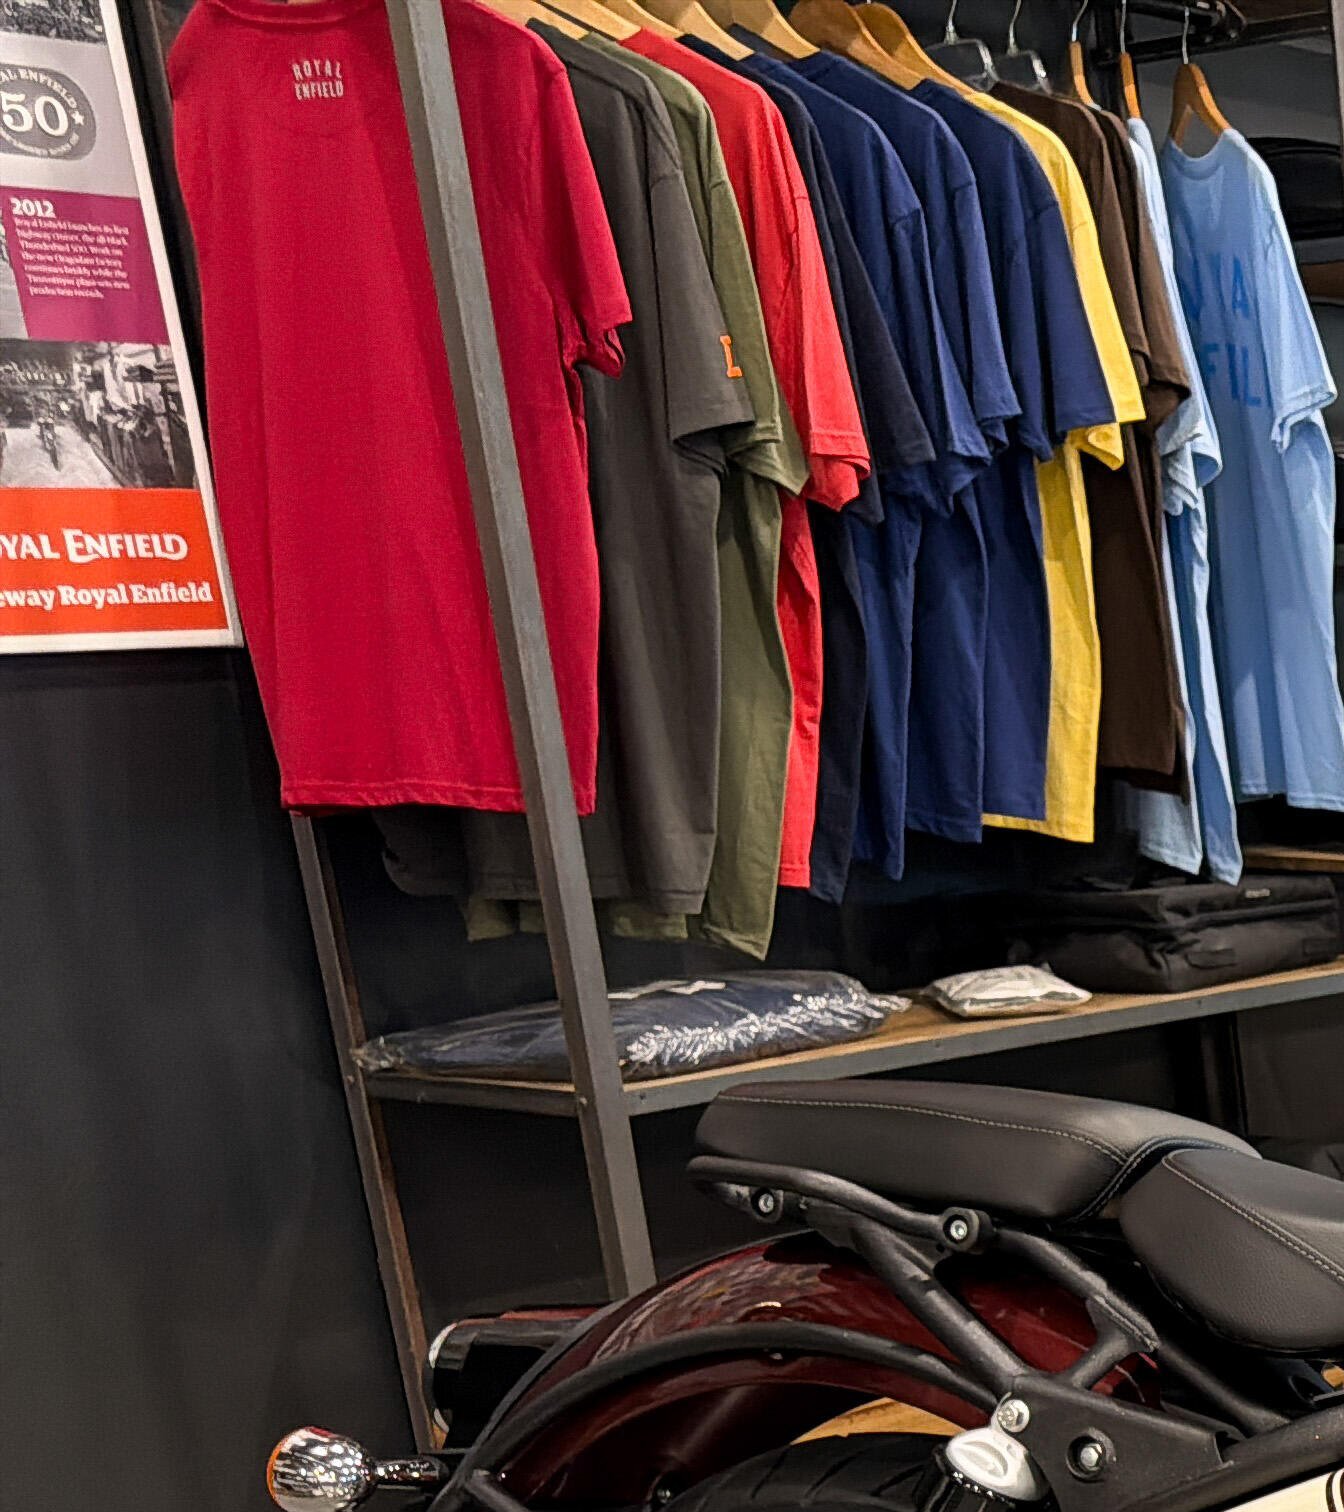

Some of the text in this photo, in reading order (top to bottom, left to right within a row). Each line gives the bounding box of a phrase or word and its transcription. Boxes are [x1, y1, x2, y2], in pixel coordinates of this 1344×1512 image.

[291, 59, 343, 81] ROYAL
[294, 79, 344, 100] ENFIELD
[9, 197, 57, 219] 2012
[0, 527, 189, 564] YAL ENFIELD
[57, 583, 130, 610] Royal
[129, 580, 214, 605] Enfield
